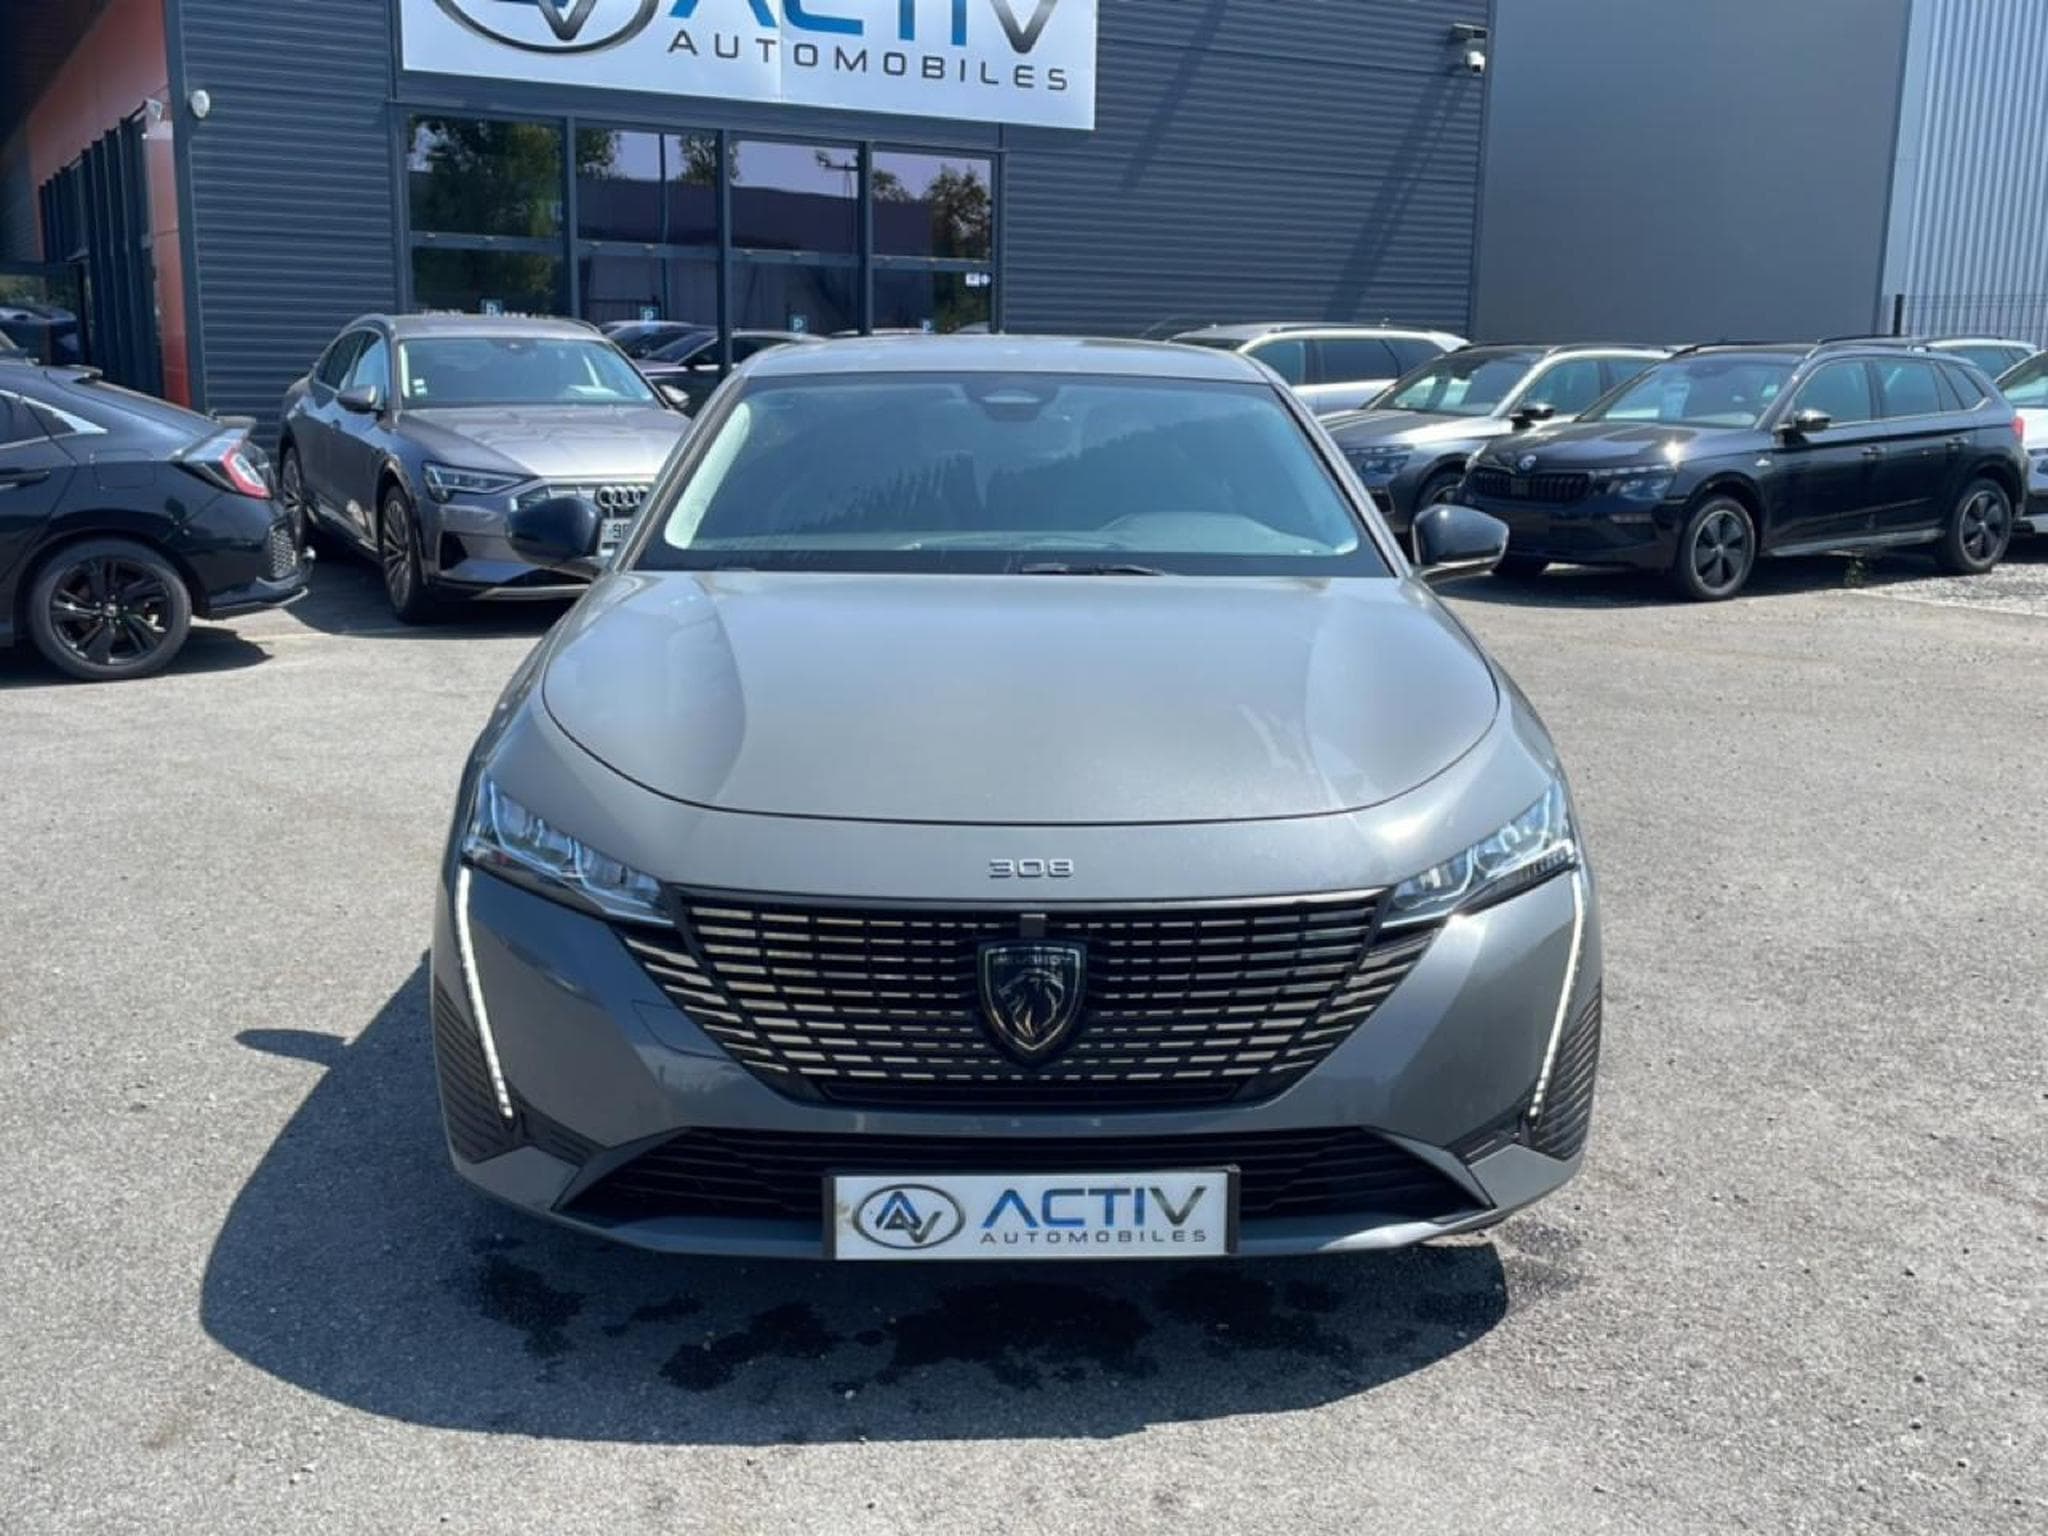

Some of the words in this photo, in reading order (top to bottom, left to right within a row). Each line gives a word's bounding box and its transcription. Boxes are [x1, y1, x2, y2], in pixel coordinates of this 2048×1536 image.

[667, 29, 1068, 91] AUTOMOBILES
[989, 858, 1074, 879] 308
[980, 1186, 1207, 1228] ACTIV
[980, 1229, 1207, 1244] AUTOMOBILES
